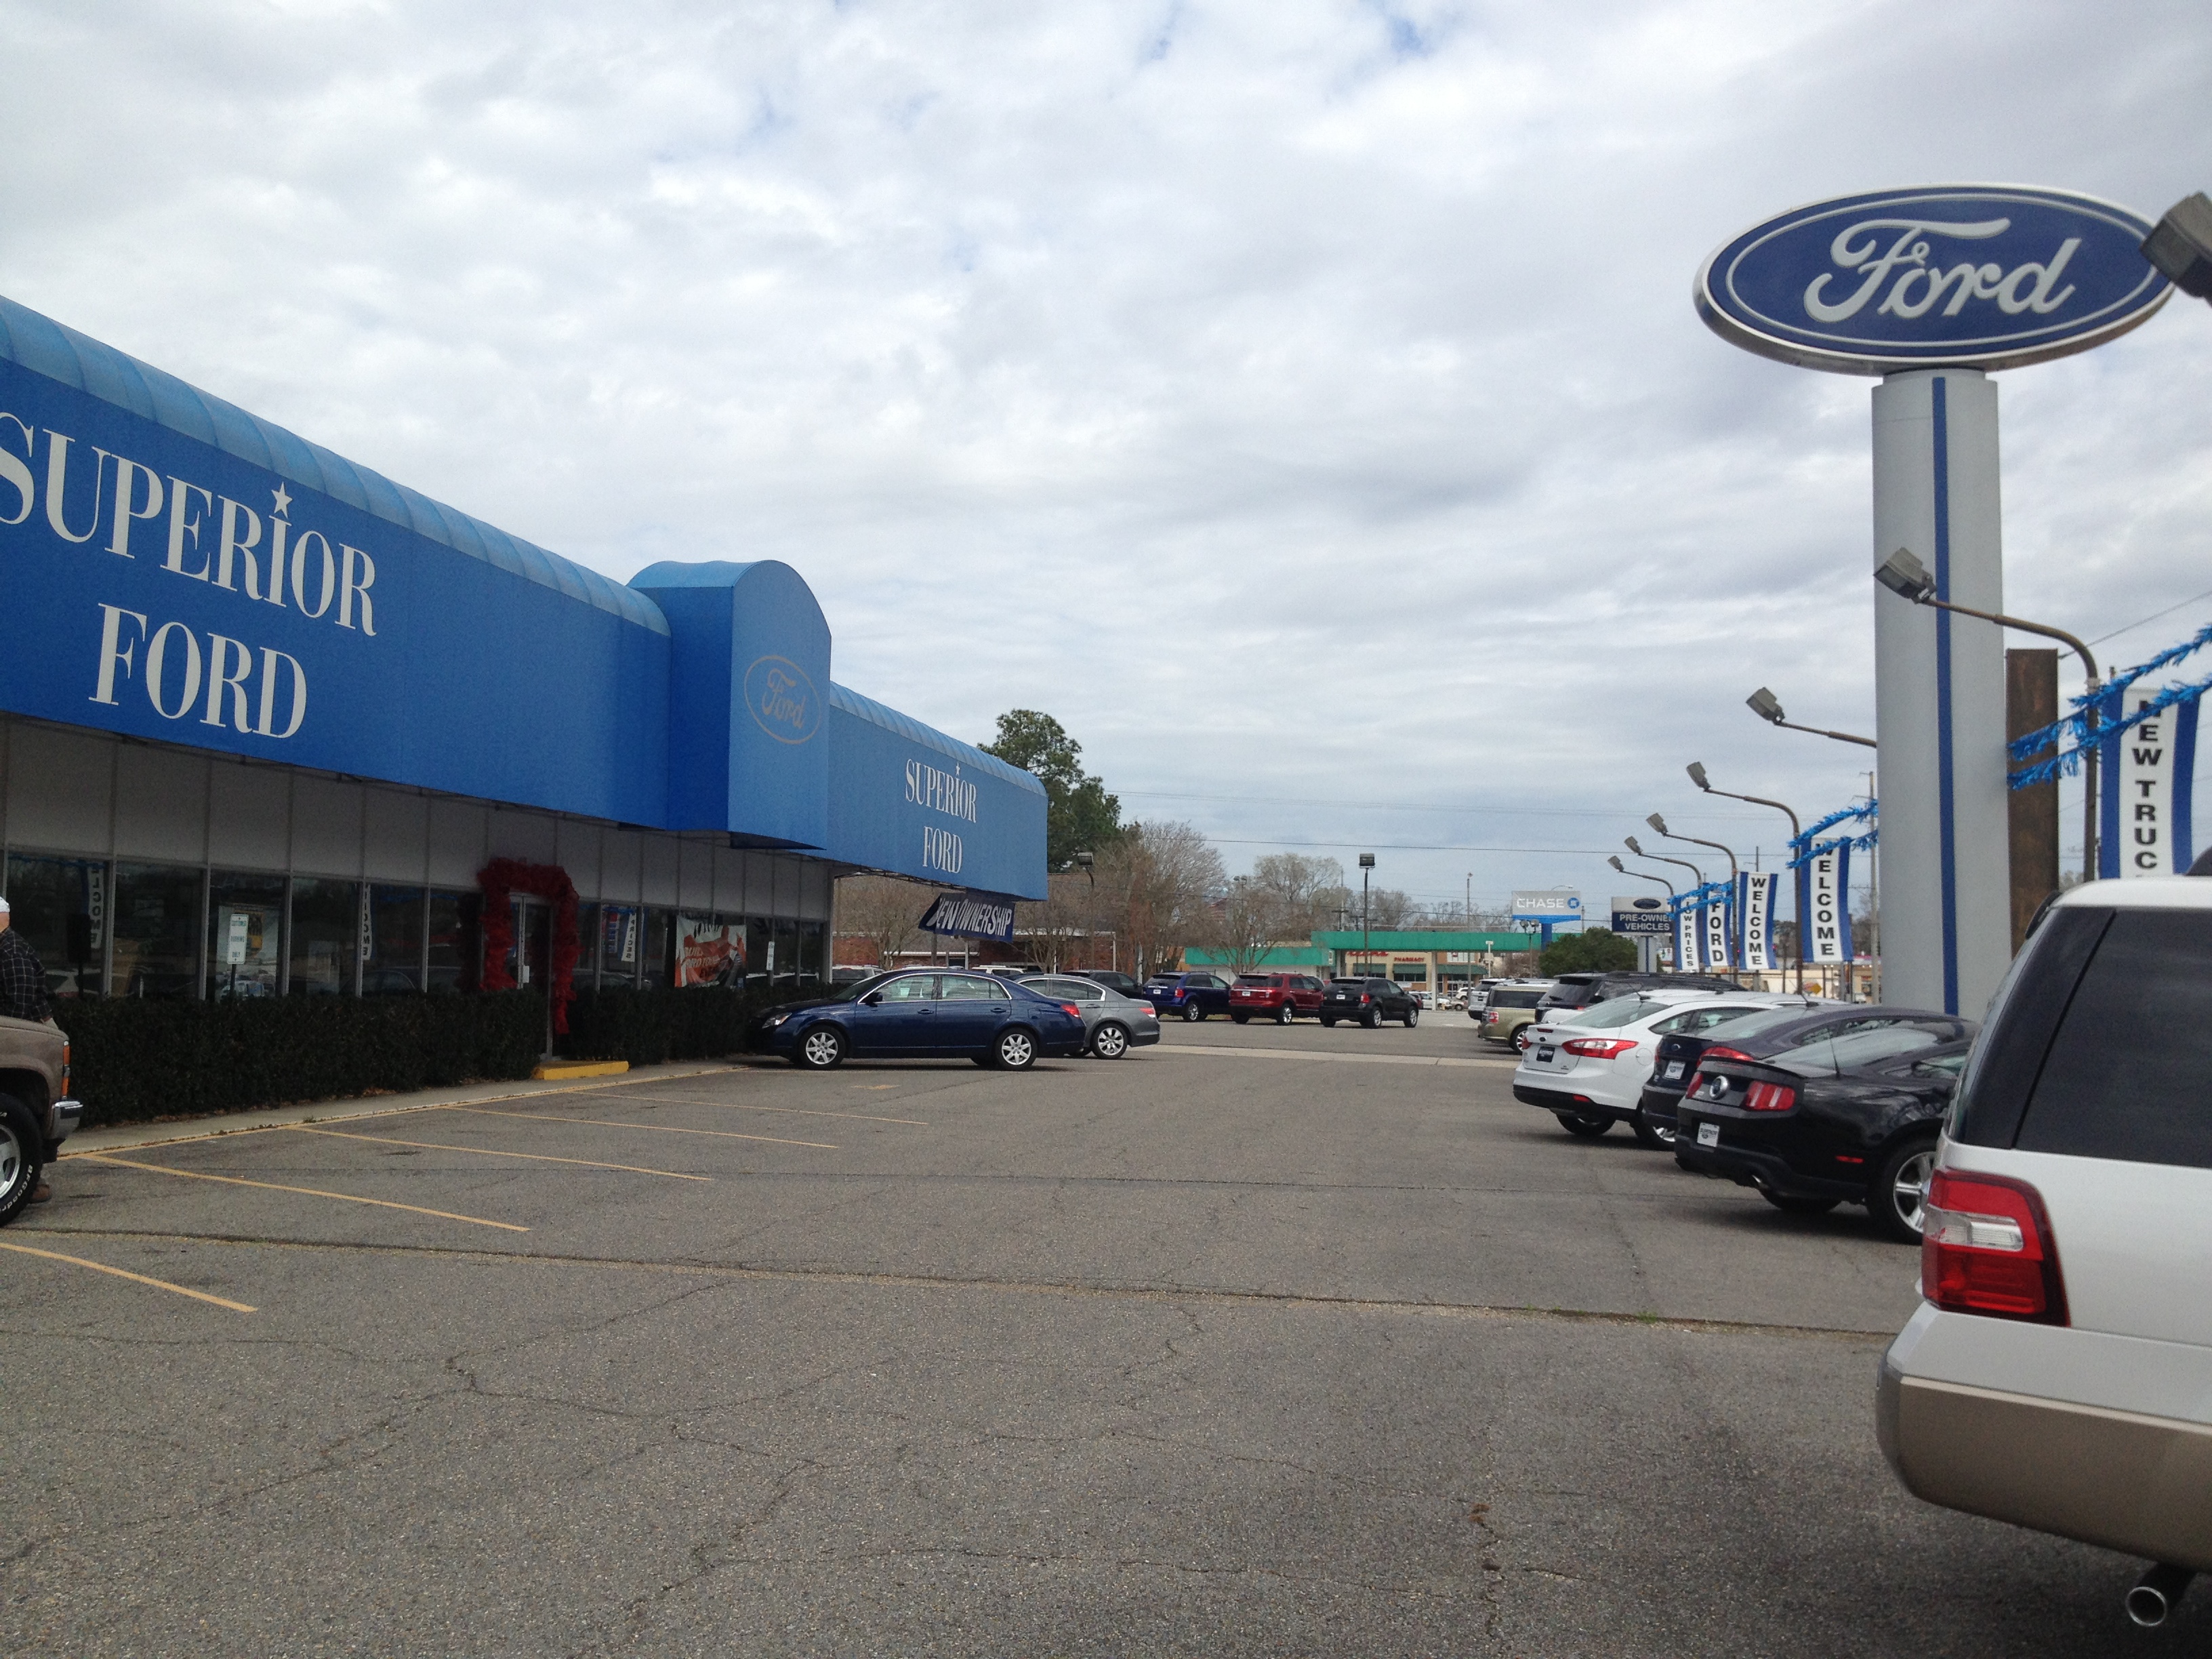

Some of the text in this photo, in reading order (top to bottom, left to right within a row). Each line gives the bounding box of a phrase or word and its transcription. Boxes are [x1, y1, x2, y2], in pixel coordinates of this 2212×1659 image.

[1803, 218, 2082, 323] Ford
[0, 412, 377, 637] SUPERIOR
[89, 602, 308, 739] FORD
[762, 668, 807, 729] Ford
[905, 758, 977, 823] SUPERIOR
[922, 826, 963, 874] FORD
[2134, 780, 2158, 876] TRUC
[956, 898, 1012, 937] OWNERSHIP
[1517, 898, 1565, 908] CHASE
[1619, 914, 1672, 922] PRE-OWNE
[1625, 922, 1671, 930] VEHICLES
[1710, 901, 1724, 962] FORD
[1748, 877, 1767, 965] WELCOME
[1685, 926, 1694, 966] PRICES
[0, 1164, 33, 1212] BFGoodr
